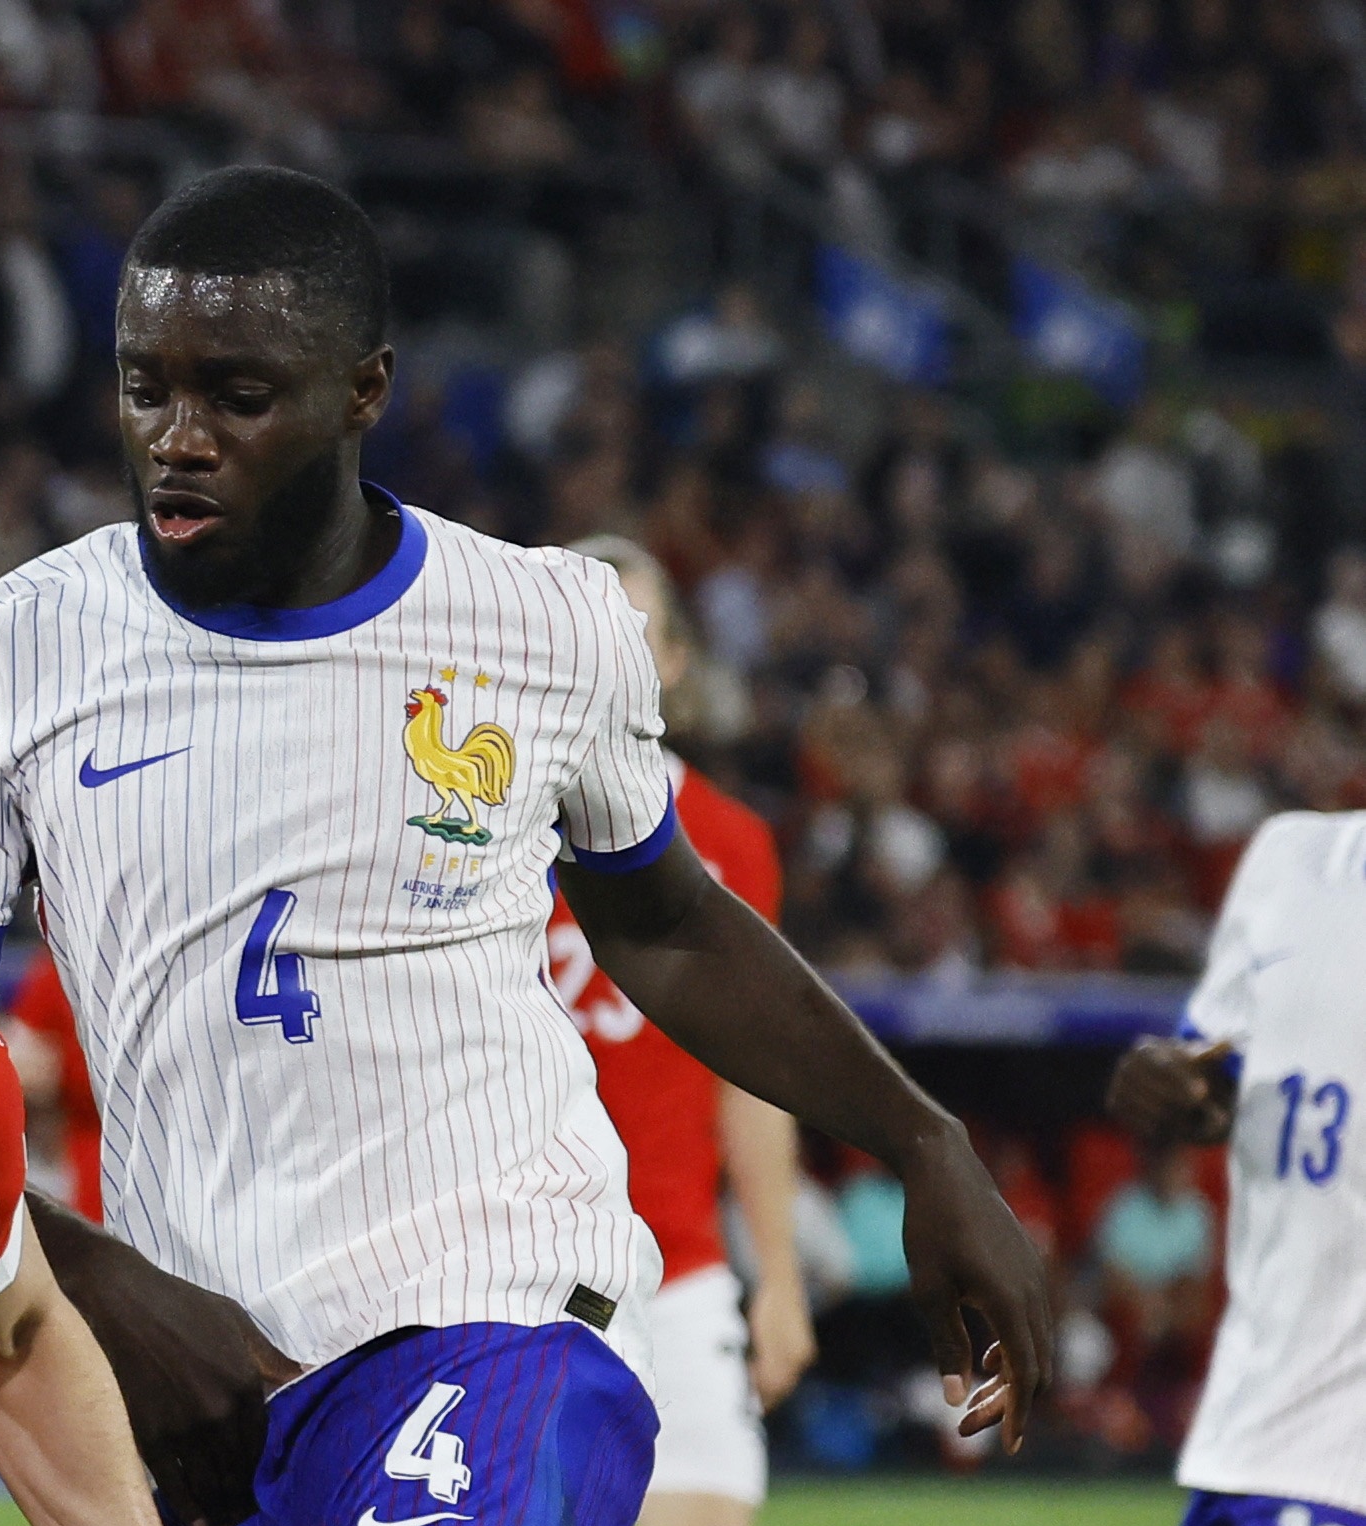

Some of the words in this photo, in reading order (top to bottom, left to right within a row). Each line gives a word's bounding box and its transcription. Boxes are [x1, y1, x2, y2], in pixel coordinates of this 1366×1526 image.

[235, 888, 321, 1044] 4
[1275, 1073, 1350, 1187] 13
[384, 1381, 472, 1505] 4
